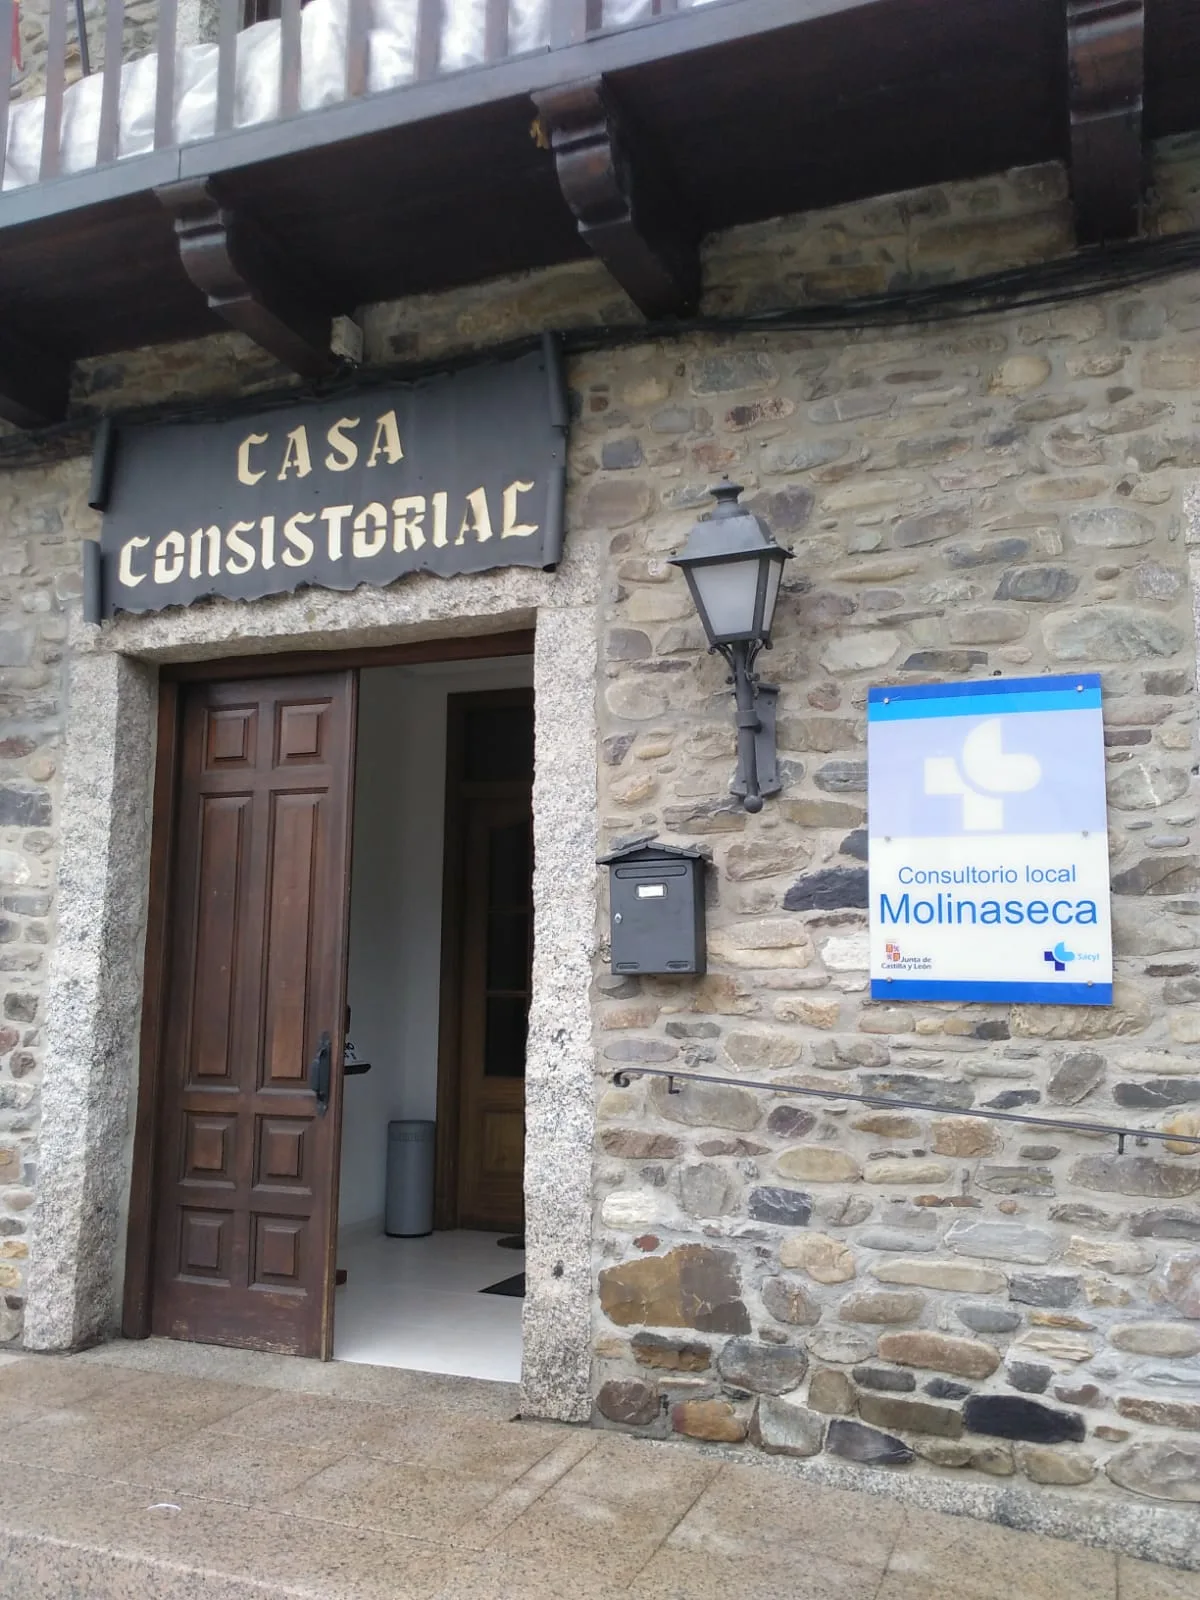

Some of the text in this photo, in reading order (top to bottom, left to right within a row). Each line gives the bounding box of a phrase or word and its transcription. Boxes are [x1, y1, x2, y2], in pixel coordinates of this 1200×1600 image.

[237, 409, 405, 486] CASA
[118, 480, 539, 588] CONSISTORIAL
[898, 865, 1077, 885] Consultorio local
[880, 893, 1098, 925] Molinaseca
